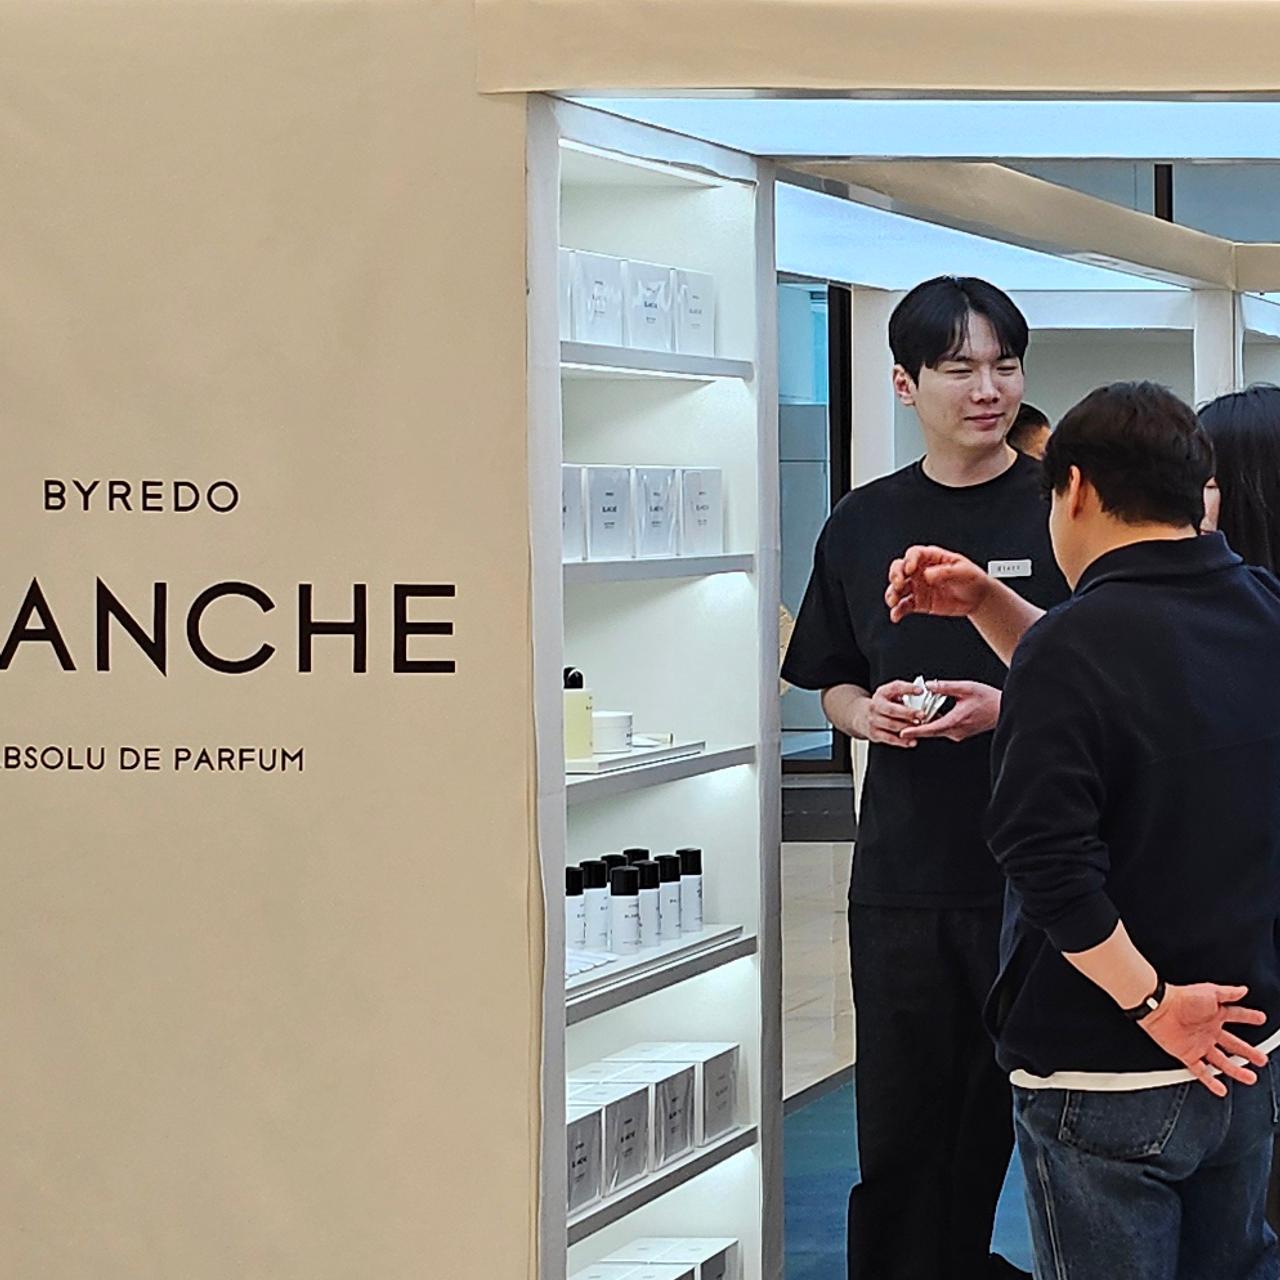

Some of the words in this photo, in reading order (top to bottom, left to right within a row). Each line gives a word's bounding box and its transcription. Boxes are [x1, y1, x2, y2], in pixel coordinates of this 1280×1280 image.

[44, 479, 239, 513] BYREDO
[0, 746, 105, 770] BSOLU
[120, 747, 161, 771] DE
[174, 747, 304, 772] PARFUM
